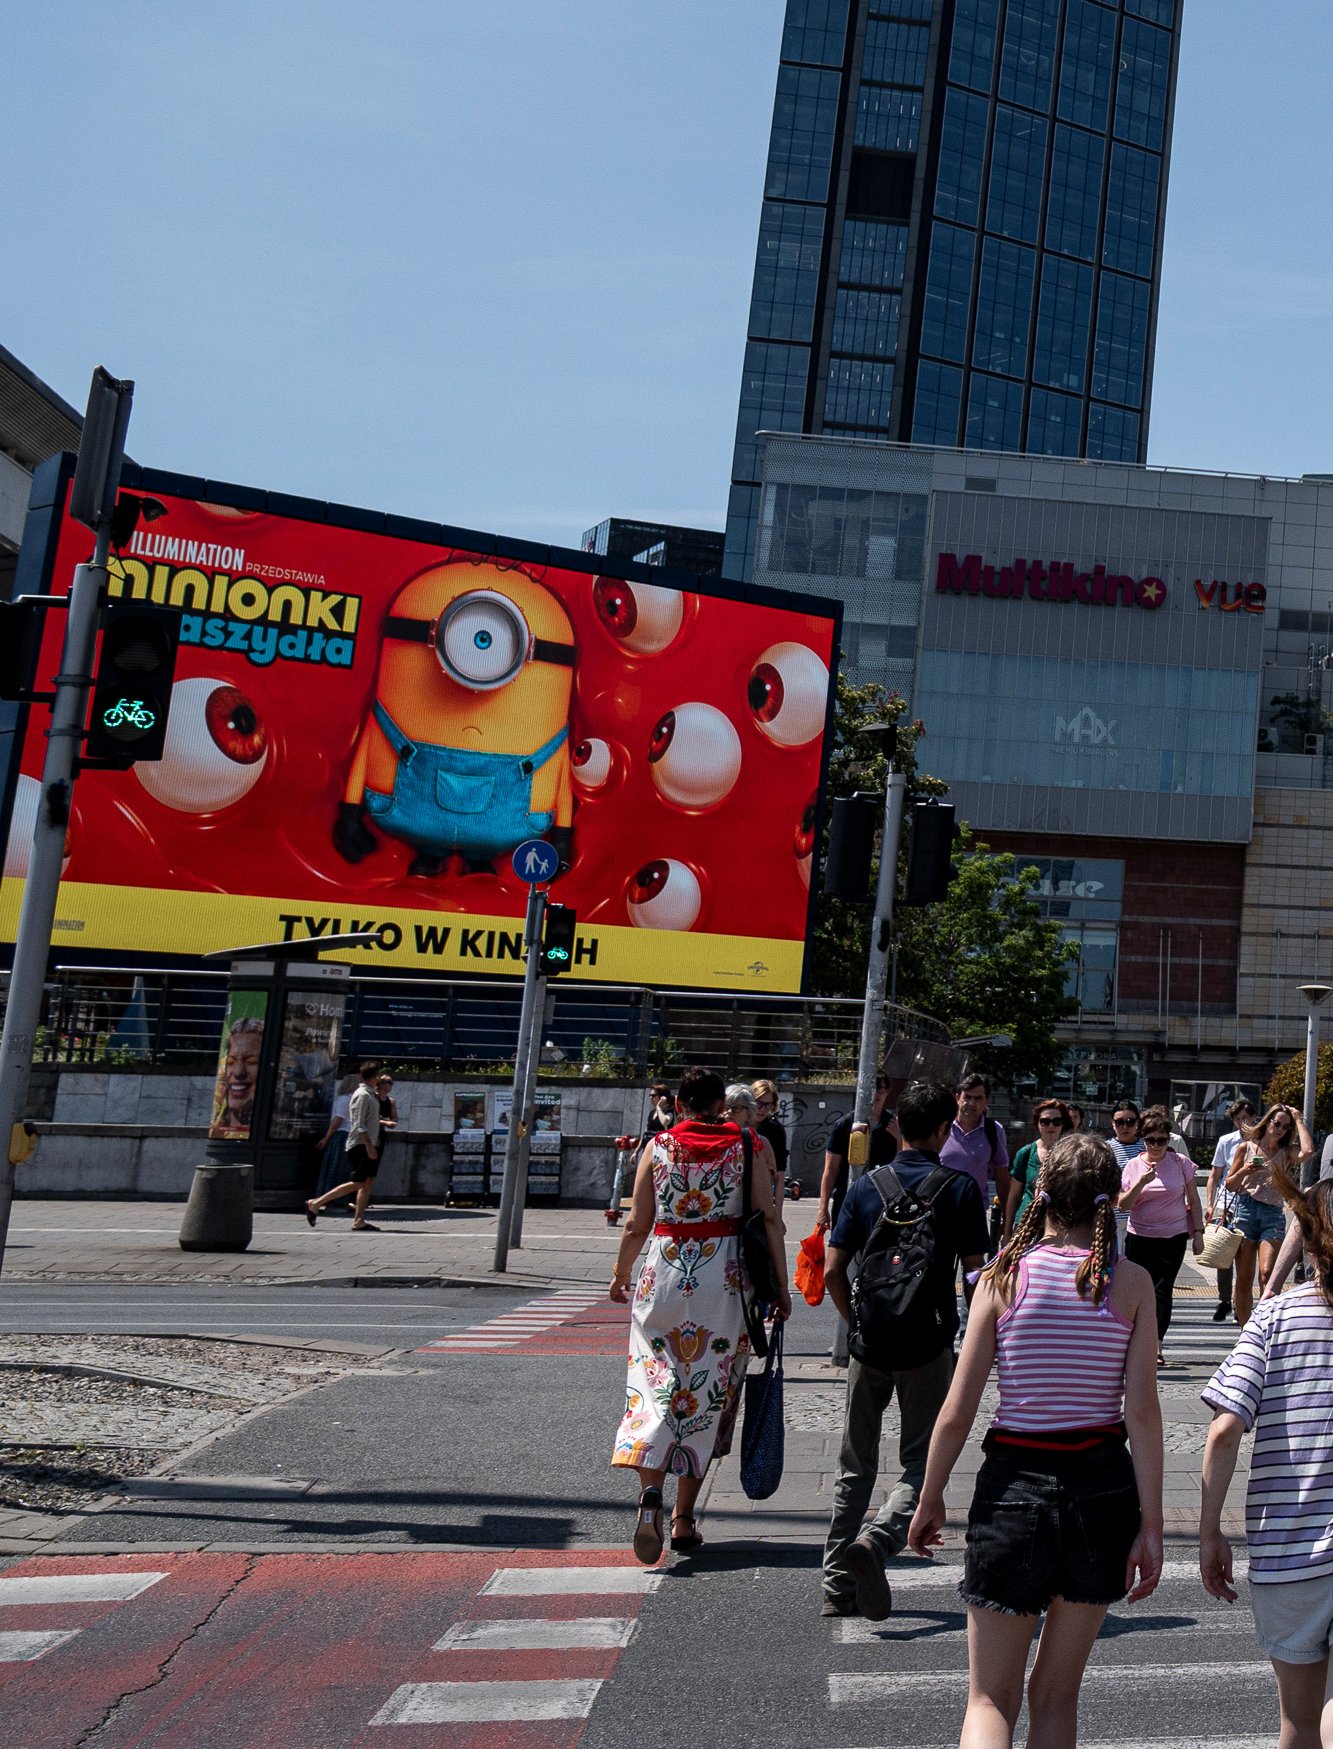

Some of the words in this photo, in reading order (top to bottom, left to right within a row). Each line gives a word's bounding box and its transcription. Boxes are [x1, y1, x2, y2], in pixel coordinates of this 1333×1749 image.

[130, 530, 245, 571] ILLUMINATION
[245, 562, 326, 586] PRZEDSTAWIA
[179, 613, 354, 666] aszydła
[413, 924, 452, 955] W
[459, 928, 599, 966] KINH
